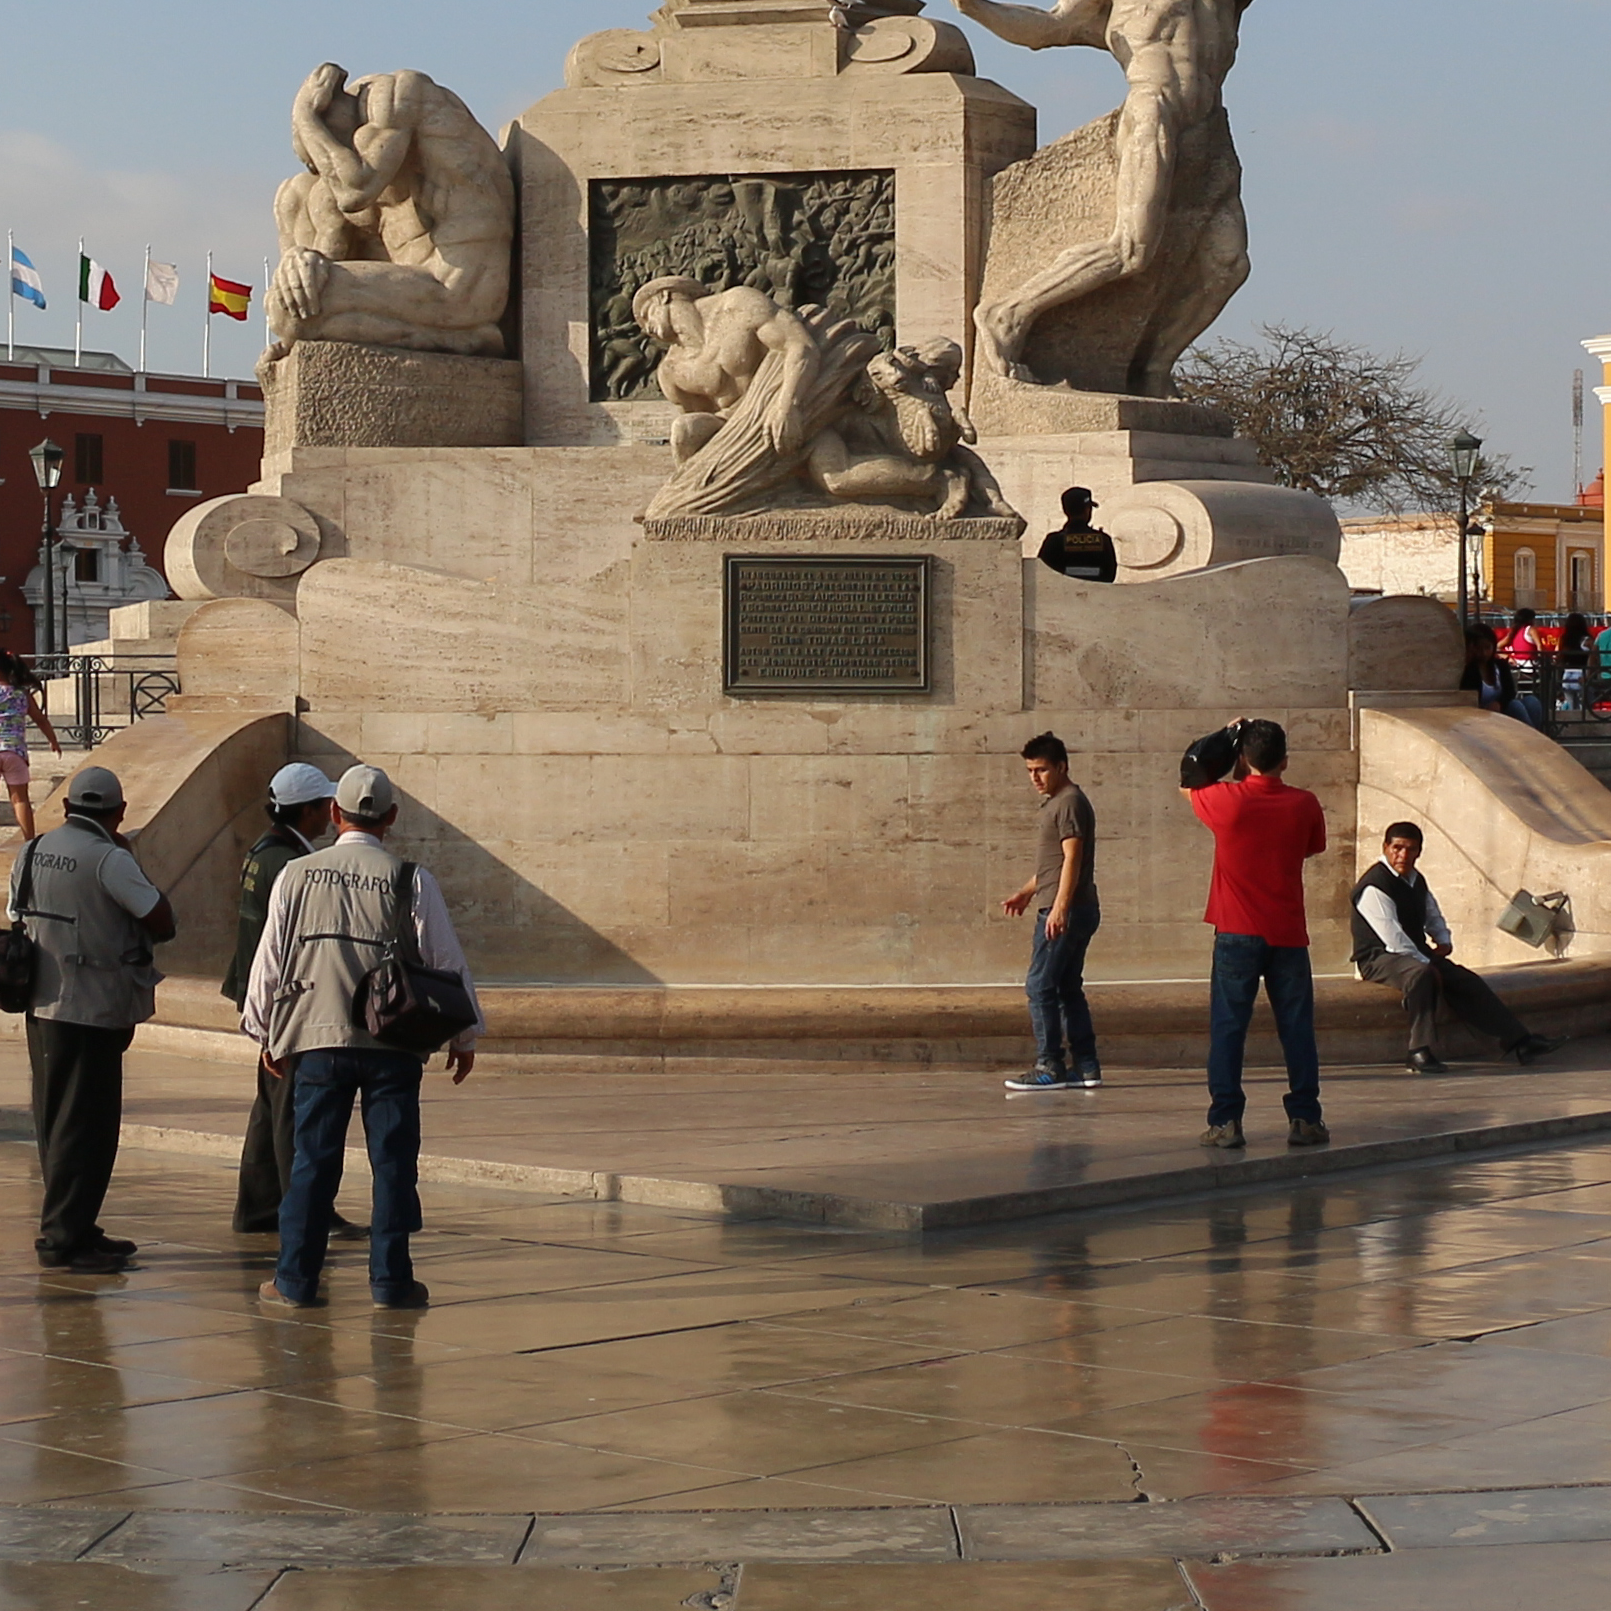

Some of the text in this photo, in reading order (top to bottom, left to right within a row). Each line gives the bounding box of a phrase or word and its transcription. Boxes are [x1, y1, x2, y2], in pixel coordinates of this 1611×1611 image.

[1066, 534, 1101, 544] POLICIA
[814, 591, 865, 601] AUGUSTO
[783, 602, 827, 612] CARMEN
[758, 668, 815, 679] ENRIQUE
[304, 868, 390, 895] FOTOGRAFO
